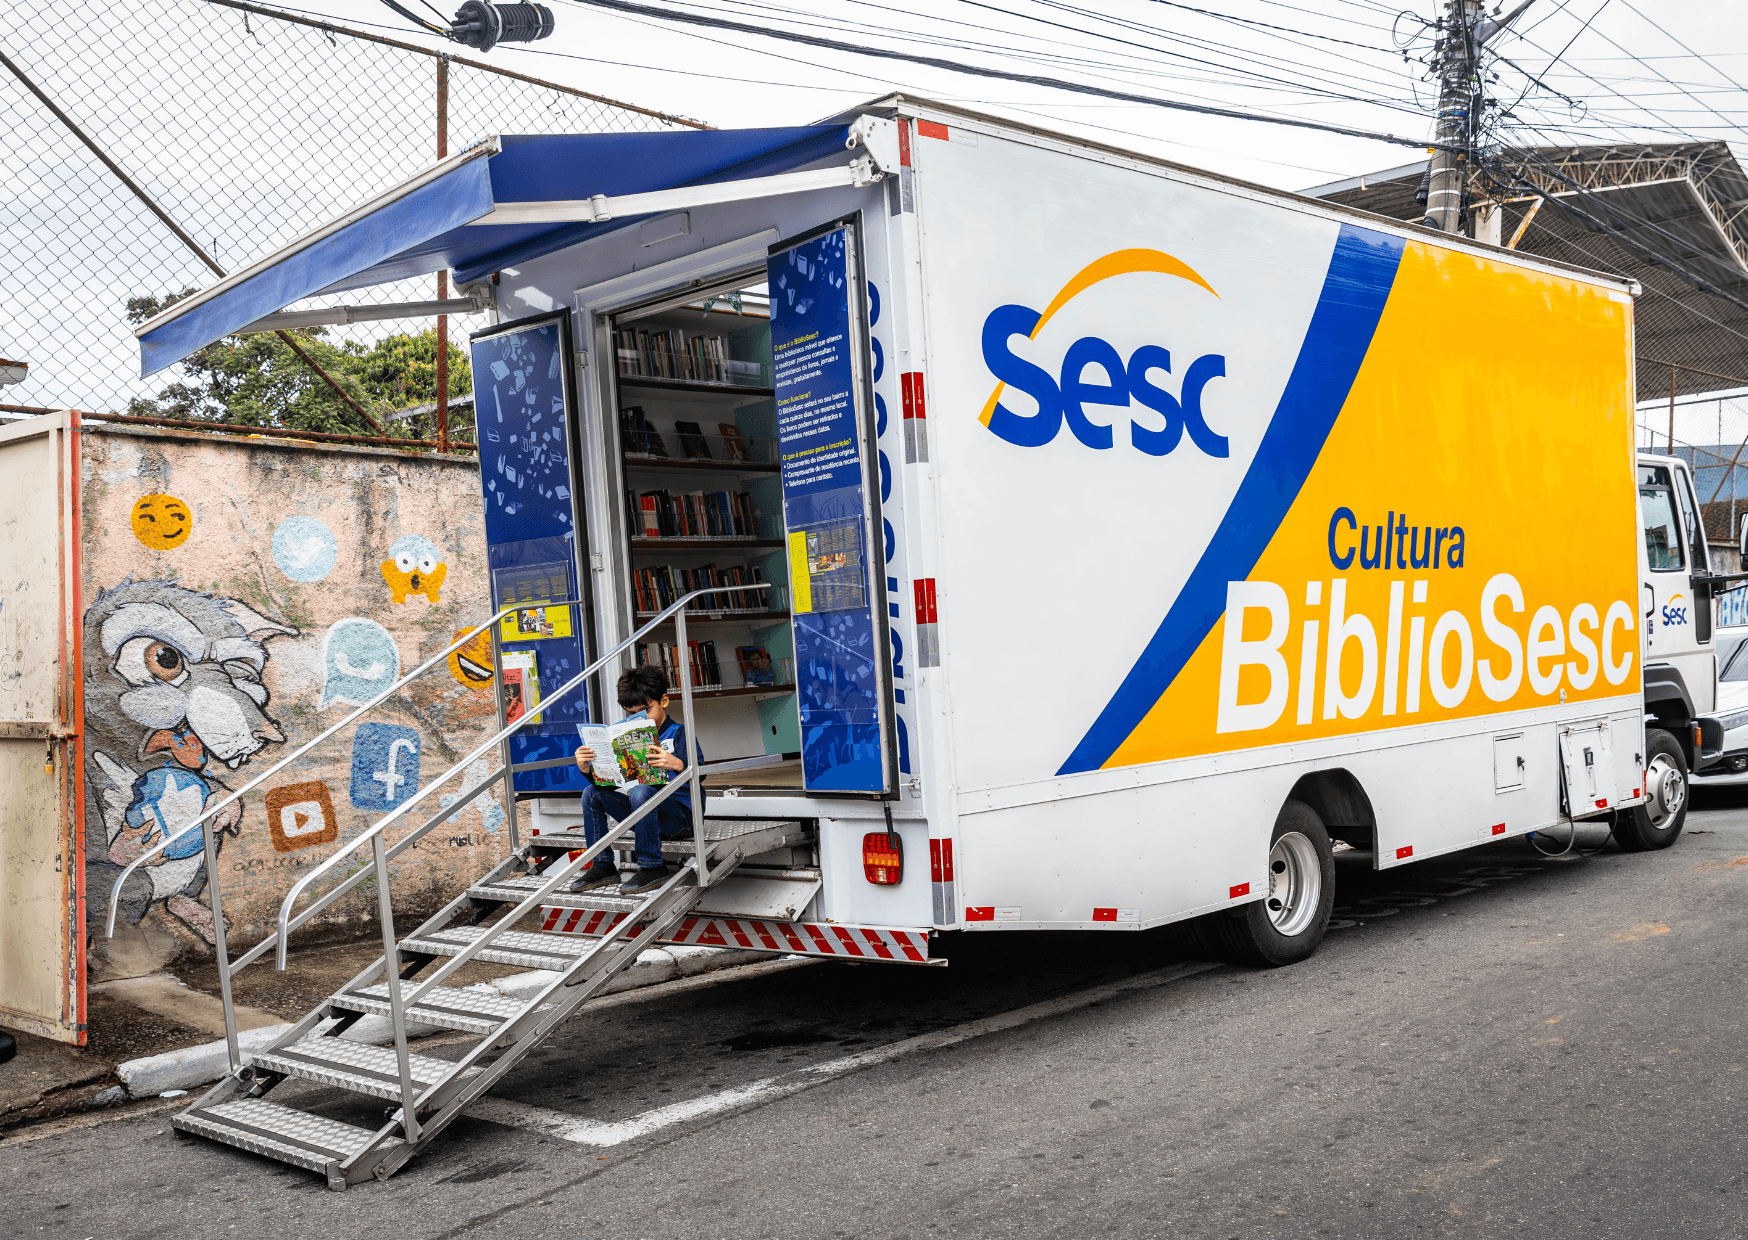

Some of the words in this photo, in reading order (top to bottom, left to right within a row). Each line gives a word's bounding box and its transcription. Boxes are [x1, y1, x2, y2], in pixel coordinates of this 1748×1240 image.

[785, 347, 804, 358] biblioteca
[805, 341, 817, 351] móvel
[826, 334, 842, 343] oferece
[794, 331, 819, 345] BiblioSesc?
[776, 367, 801, 379] empréstimos
[808, 361, 820, 369] livros,
[821, 356, 835, 366] jornais
[779, 358, 796, 369] qualquer
[797, 354, 811, 364] pessoa
[812, 347, 832, 358] consultas
[794, 369, 822, 384] gratuitamente.
[982, 304, 1229, 458] Sesc
[783, 403, 804, 414] BiblioSesc
[804, 399, 817, 408] estará
[832, 392, 845, 400] bairro
[791, 391, 811, 402] funciona?
[790, 413, 803, 422] quinze
[820, 404, 835, 413] mesmo
[836, 400, 848, 408] local.
[798, 421, 812, 430] podem
[820, 413, 838, 423] retirados
[781, 432, 802, 443] devolvidos
[786, 459, 810, 469] Documento
[817, 451, 838, 462] identidade
[839, 447, 856, 457] original.
[787, 453, 795, 461] que
[815, 446, 825, 454] para
[829, 437, 852, 450] inscrição?
[788, 467, 815, 479] Comprovante
[821, 461, 842, 470] residência
[843, 456, 861, 466] recente.
[788, 479, 805, 487] Telefone
[806, 476, 816, 484] para
[816, 473, 833, 481] contato.
[1328, 507, 1464, 570] Cultura
[1663, 605, 1687, 626] Sesc
[1216, 573, 1634, 734] BiblioSesc
